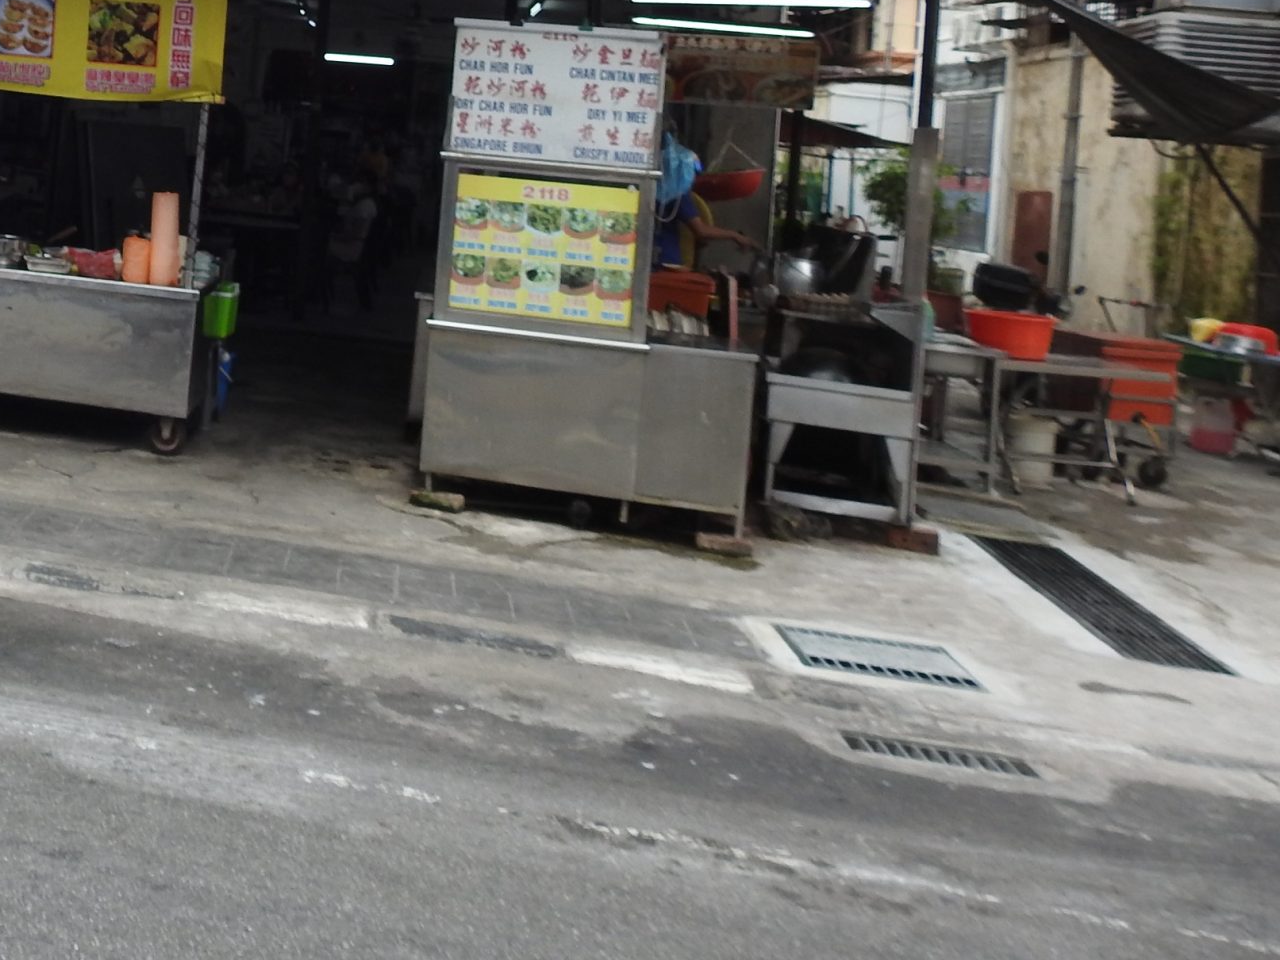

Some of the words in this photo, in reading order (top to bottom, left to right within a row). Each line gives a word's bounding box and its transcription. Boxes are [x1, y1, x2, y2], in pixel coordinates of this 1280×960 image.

[459, 59, 486, 72] CHAR
[490, 61, 510, 74] HOR
[513, 62, 534, 76] FUN
[569, 66, 597, 80] CHAR
[637, 71, 660, 86] MEE
[455, 98, 474, 110] DRY
[478, 100, 505, 113] CHAR
[508, 102, 529, 115] HOR
[532, 104, 553, 117] FUN
[587, 108, 607, 121] DRY
[612, 110, 623, 122] YI
[626, 111, 648, 124] MEE
[453, 136, 508, 153] SINGAPORE
[512, 141, 543, 155] BIHUN
[573, 146, 611, 160] CRISPY
[522, 185, 569, 202] 2118
